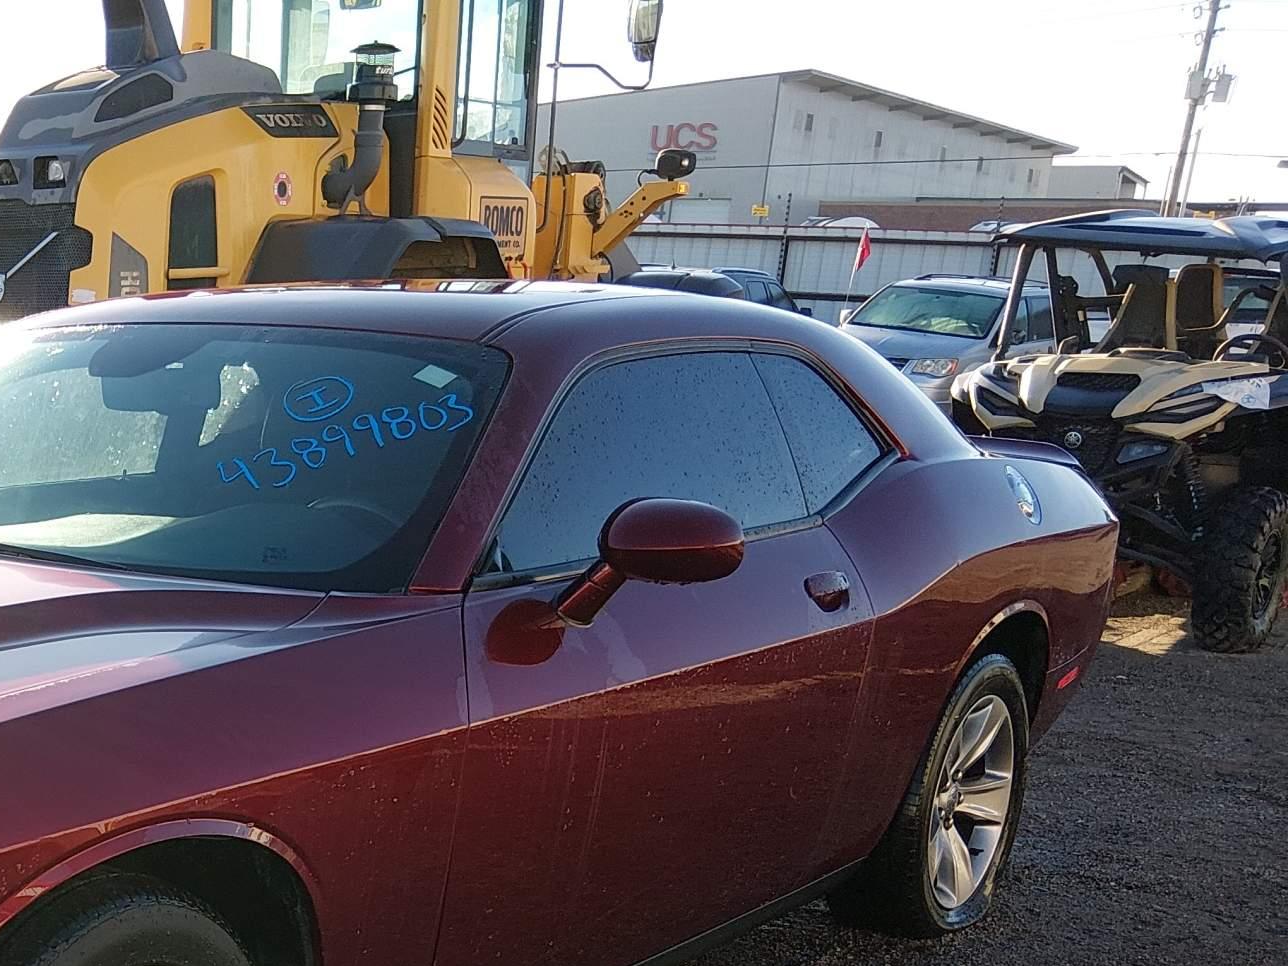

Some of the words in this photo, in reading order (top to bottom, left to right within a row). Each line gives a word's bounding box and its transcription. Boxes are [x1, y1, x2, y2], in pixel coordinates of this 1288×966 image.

[255, 112, 327, 128] VOLVO
[650, 122, 718, 152] UCS
[484, 205, 523, 236] ROMCO
[216, 394, 473, 489] 43899803
